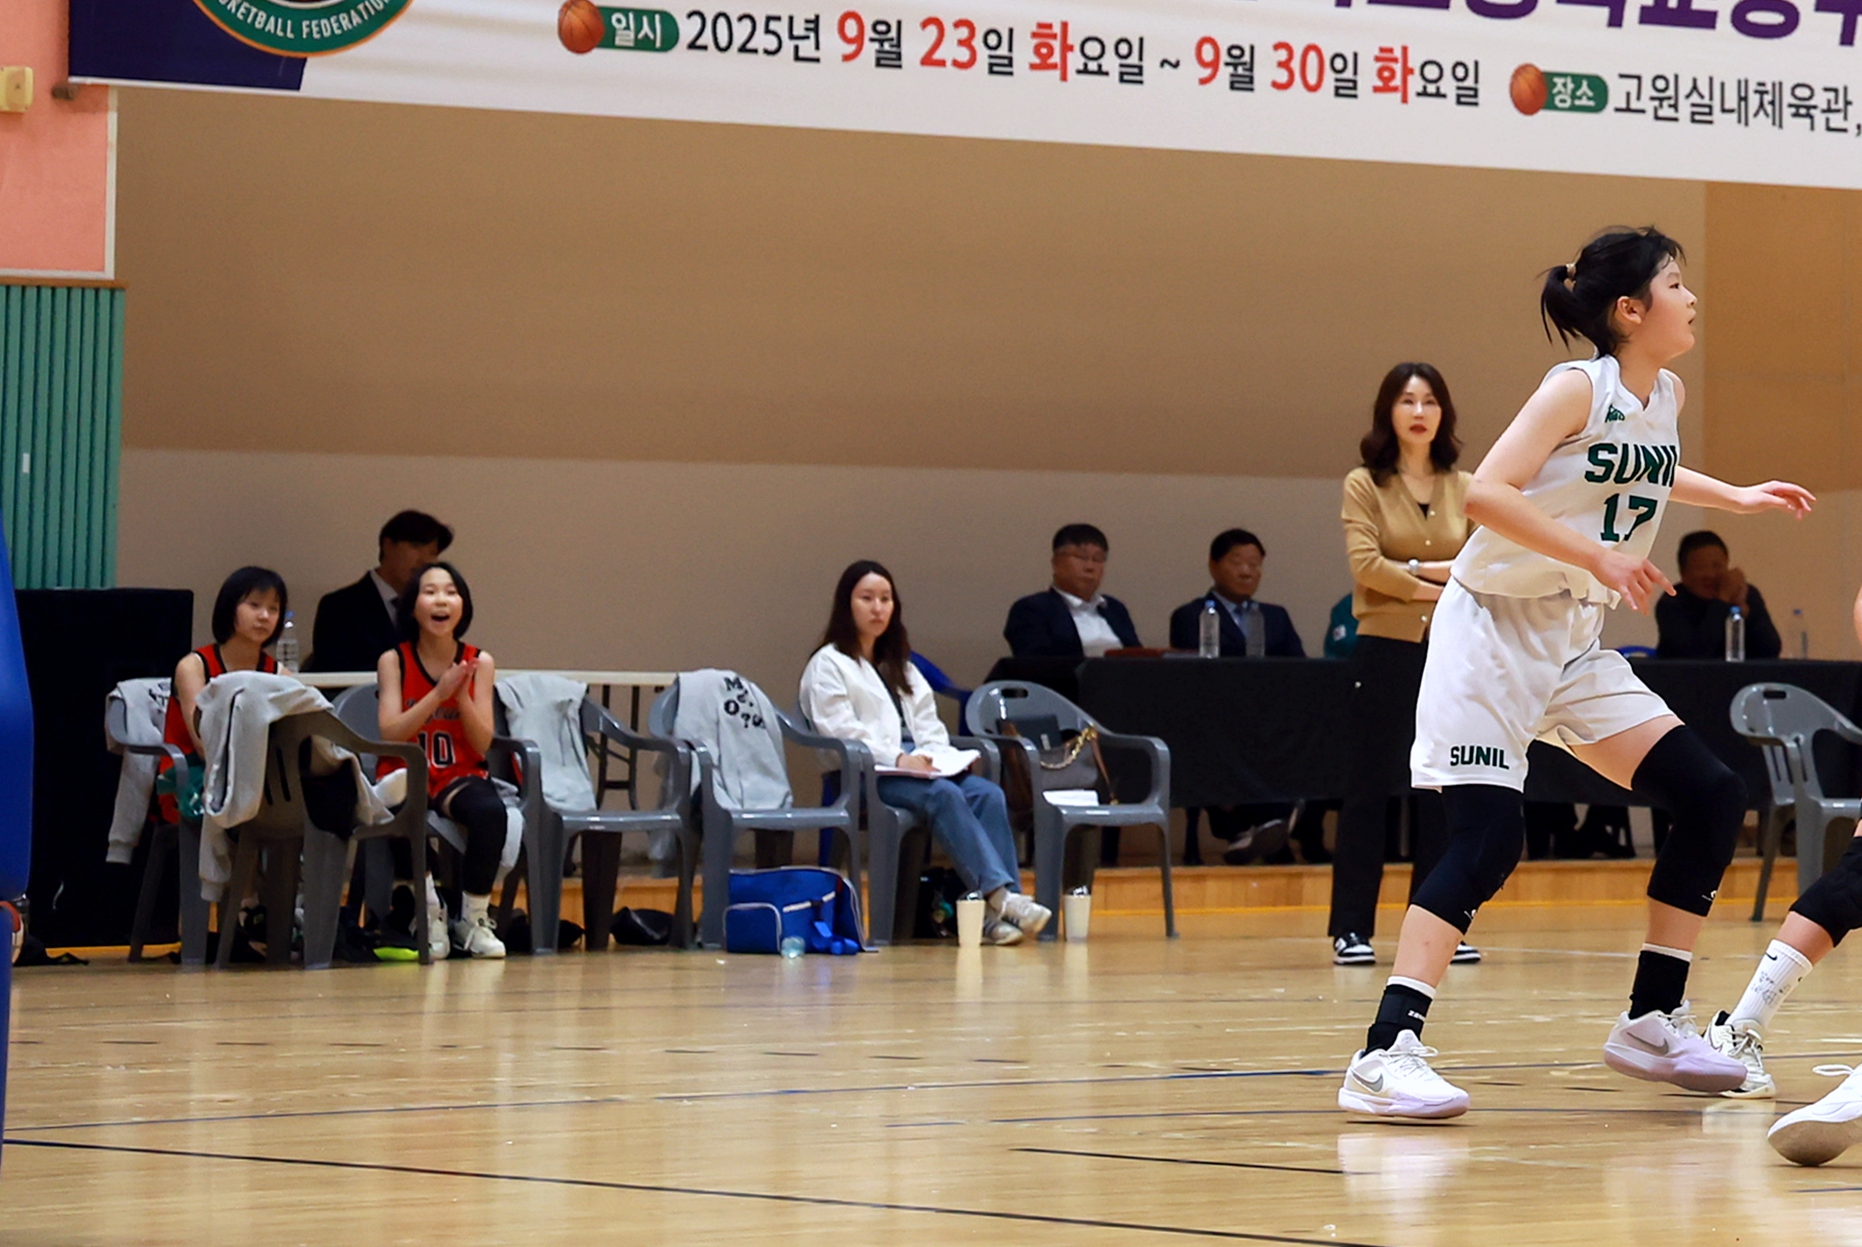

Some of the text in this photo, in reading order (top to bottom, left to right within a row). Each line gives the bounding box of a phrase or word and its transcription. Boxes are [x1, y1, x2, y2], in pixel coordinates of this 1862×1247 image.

[610, 11, 663, 48] 일시
[686, 10, 820, 63] 2025년
[837, 10, 903, 69] 9월
[919, 15, 1015, 76] 23일
[1029, 20, 1144, 85] 화요일
[1194, 35, 1255, 92] 9월
[1270, 41, 1359, 99] 30일
[1372, 44, 1480, 107] 화요일
[1552, 75, 1596, 109] 장소
[1614, 71, 1862, 137] 고원실내체육관,
[1600, 493, 1659, 543] 17
[1449, 745, 1510, 771] SUNIL
